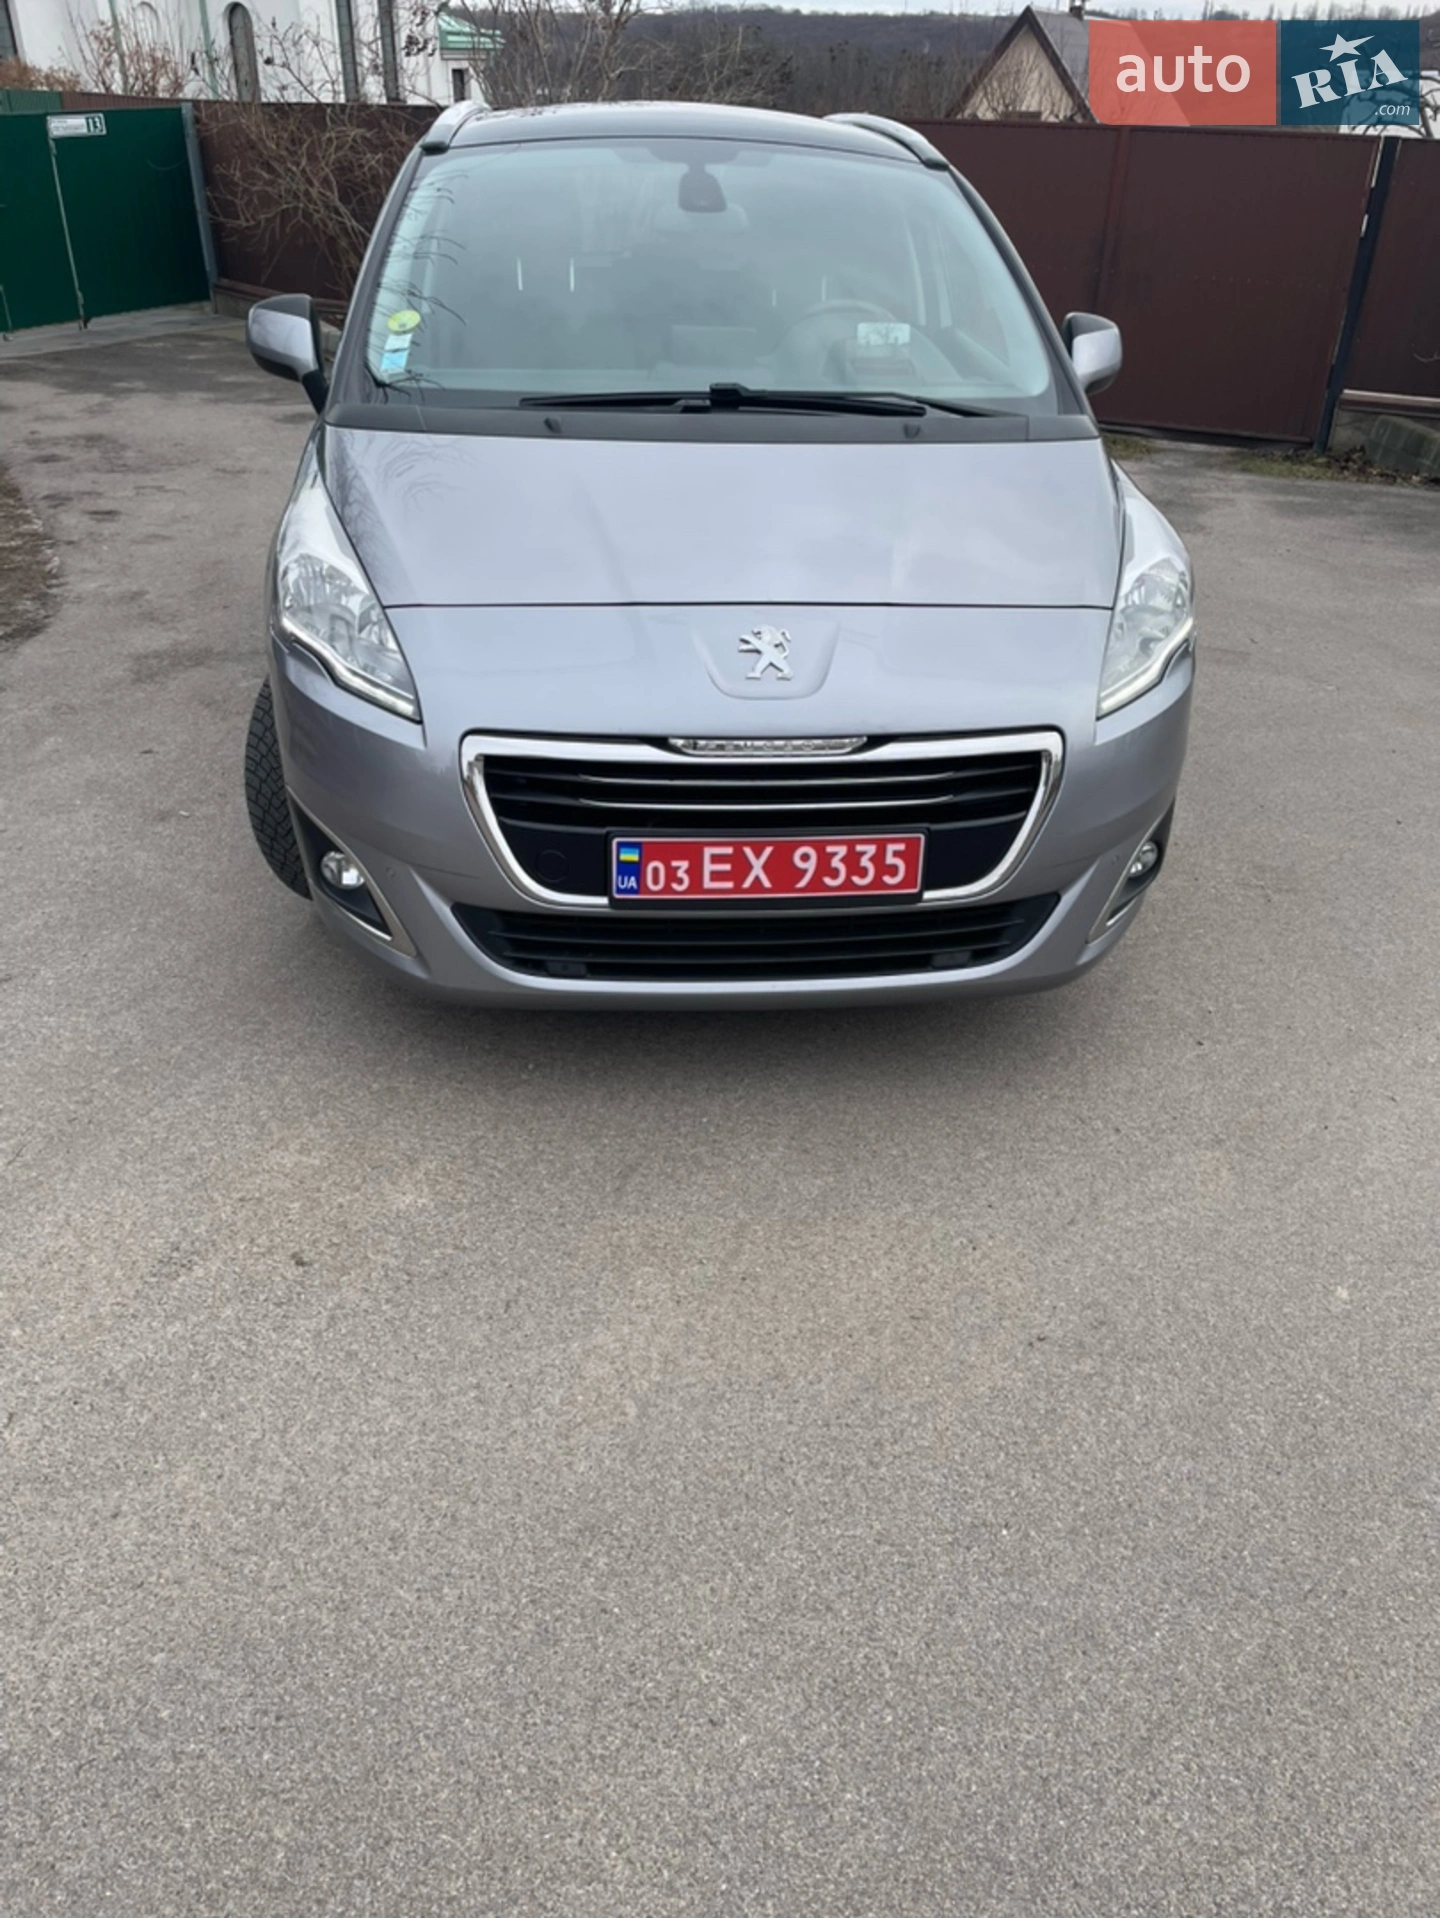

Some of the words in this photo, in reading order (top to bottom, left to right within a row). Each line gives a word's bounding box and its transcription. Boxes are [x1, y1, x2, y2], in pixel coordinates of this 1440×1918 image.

[646, 860, 690, 891] 03
[703, 847, 774, 889] EX
[793, 843, 906, 887] 9335
[618, 876, 637, 889] UA
